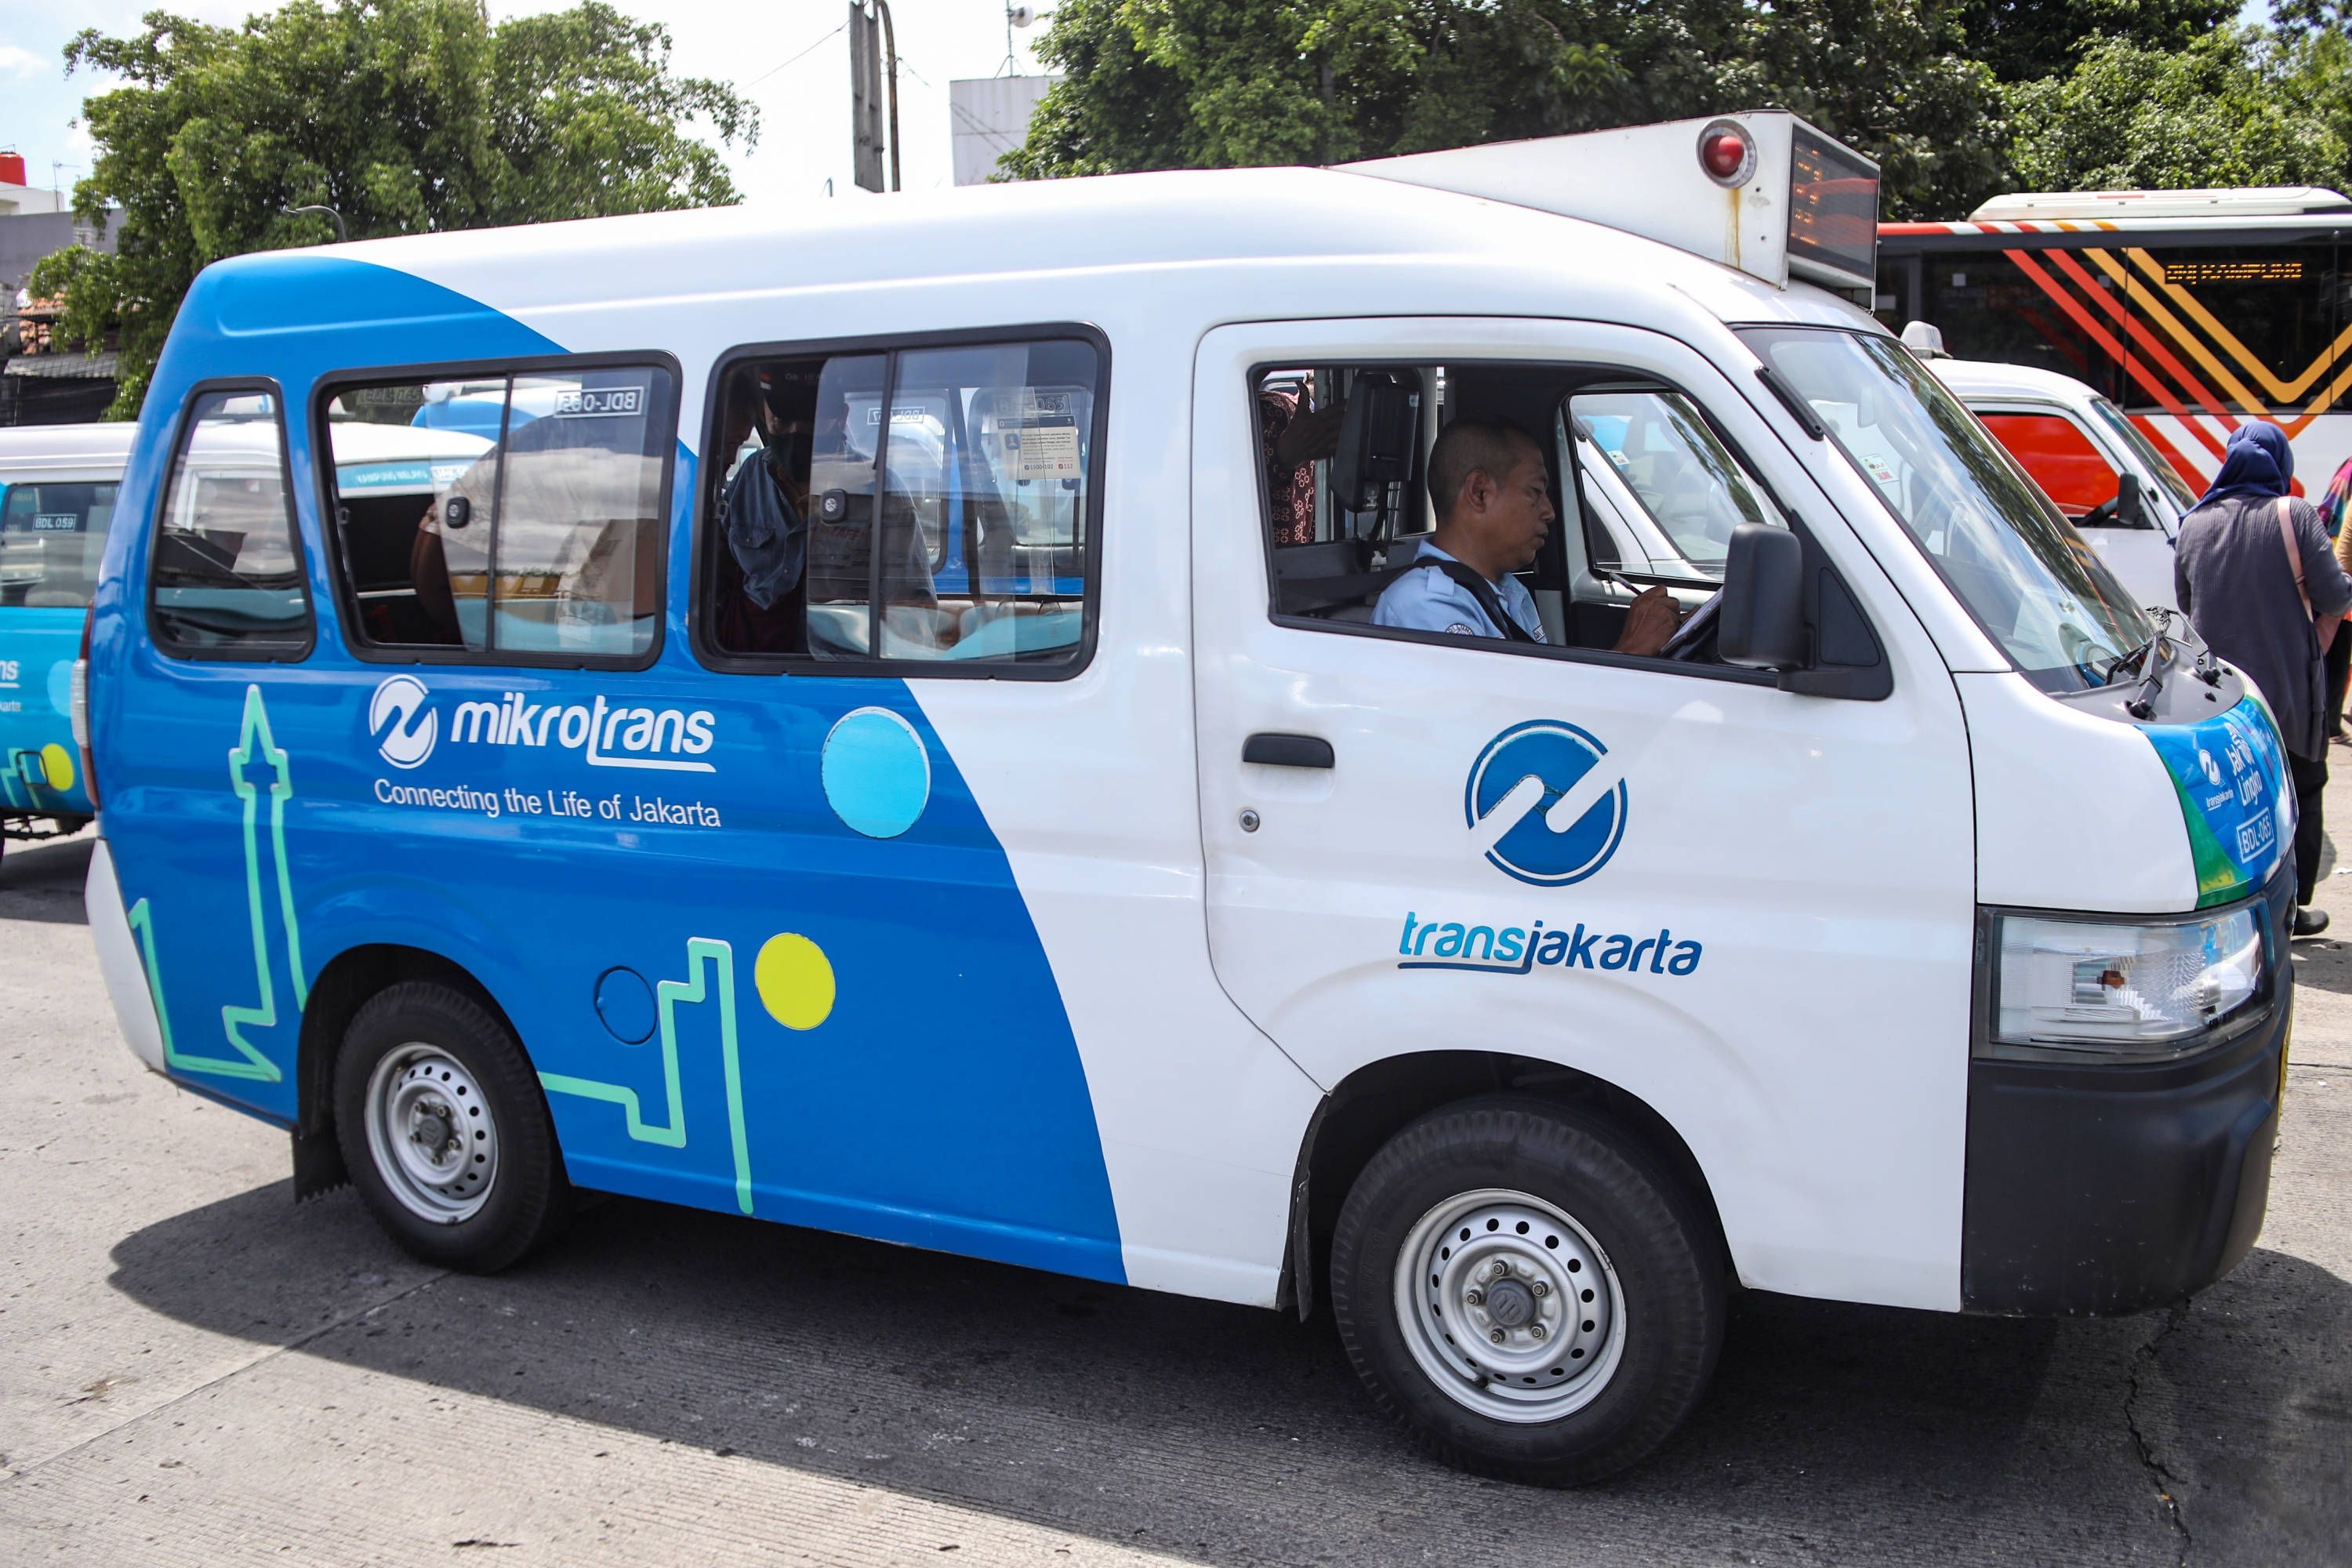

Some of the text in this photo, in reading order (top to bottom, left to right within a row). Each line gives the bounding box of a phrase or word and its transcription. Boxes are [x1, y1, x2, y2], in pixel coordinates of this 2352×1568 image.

[450, 691, 717, 773] mikrotrans
[2225, 743, 2245, 776] Jak
[373, 778, 721, 828] Connecting the Life of Jakarta
[2205, 789, 2234, 811] transjakarta
[2237, 768, 2263, 807] Lingko
[2241, 816, 2272, 854] BDL-065
[1396, 910, 1703, 976] transjakarta
